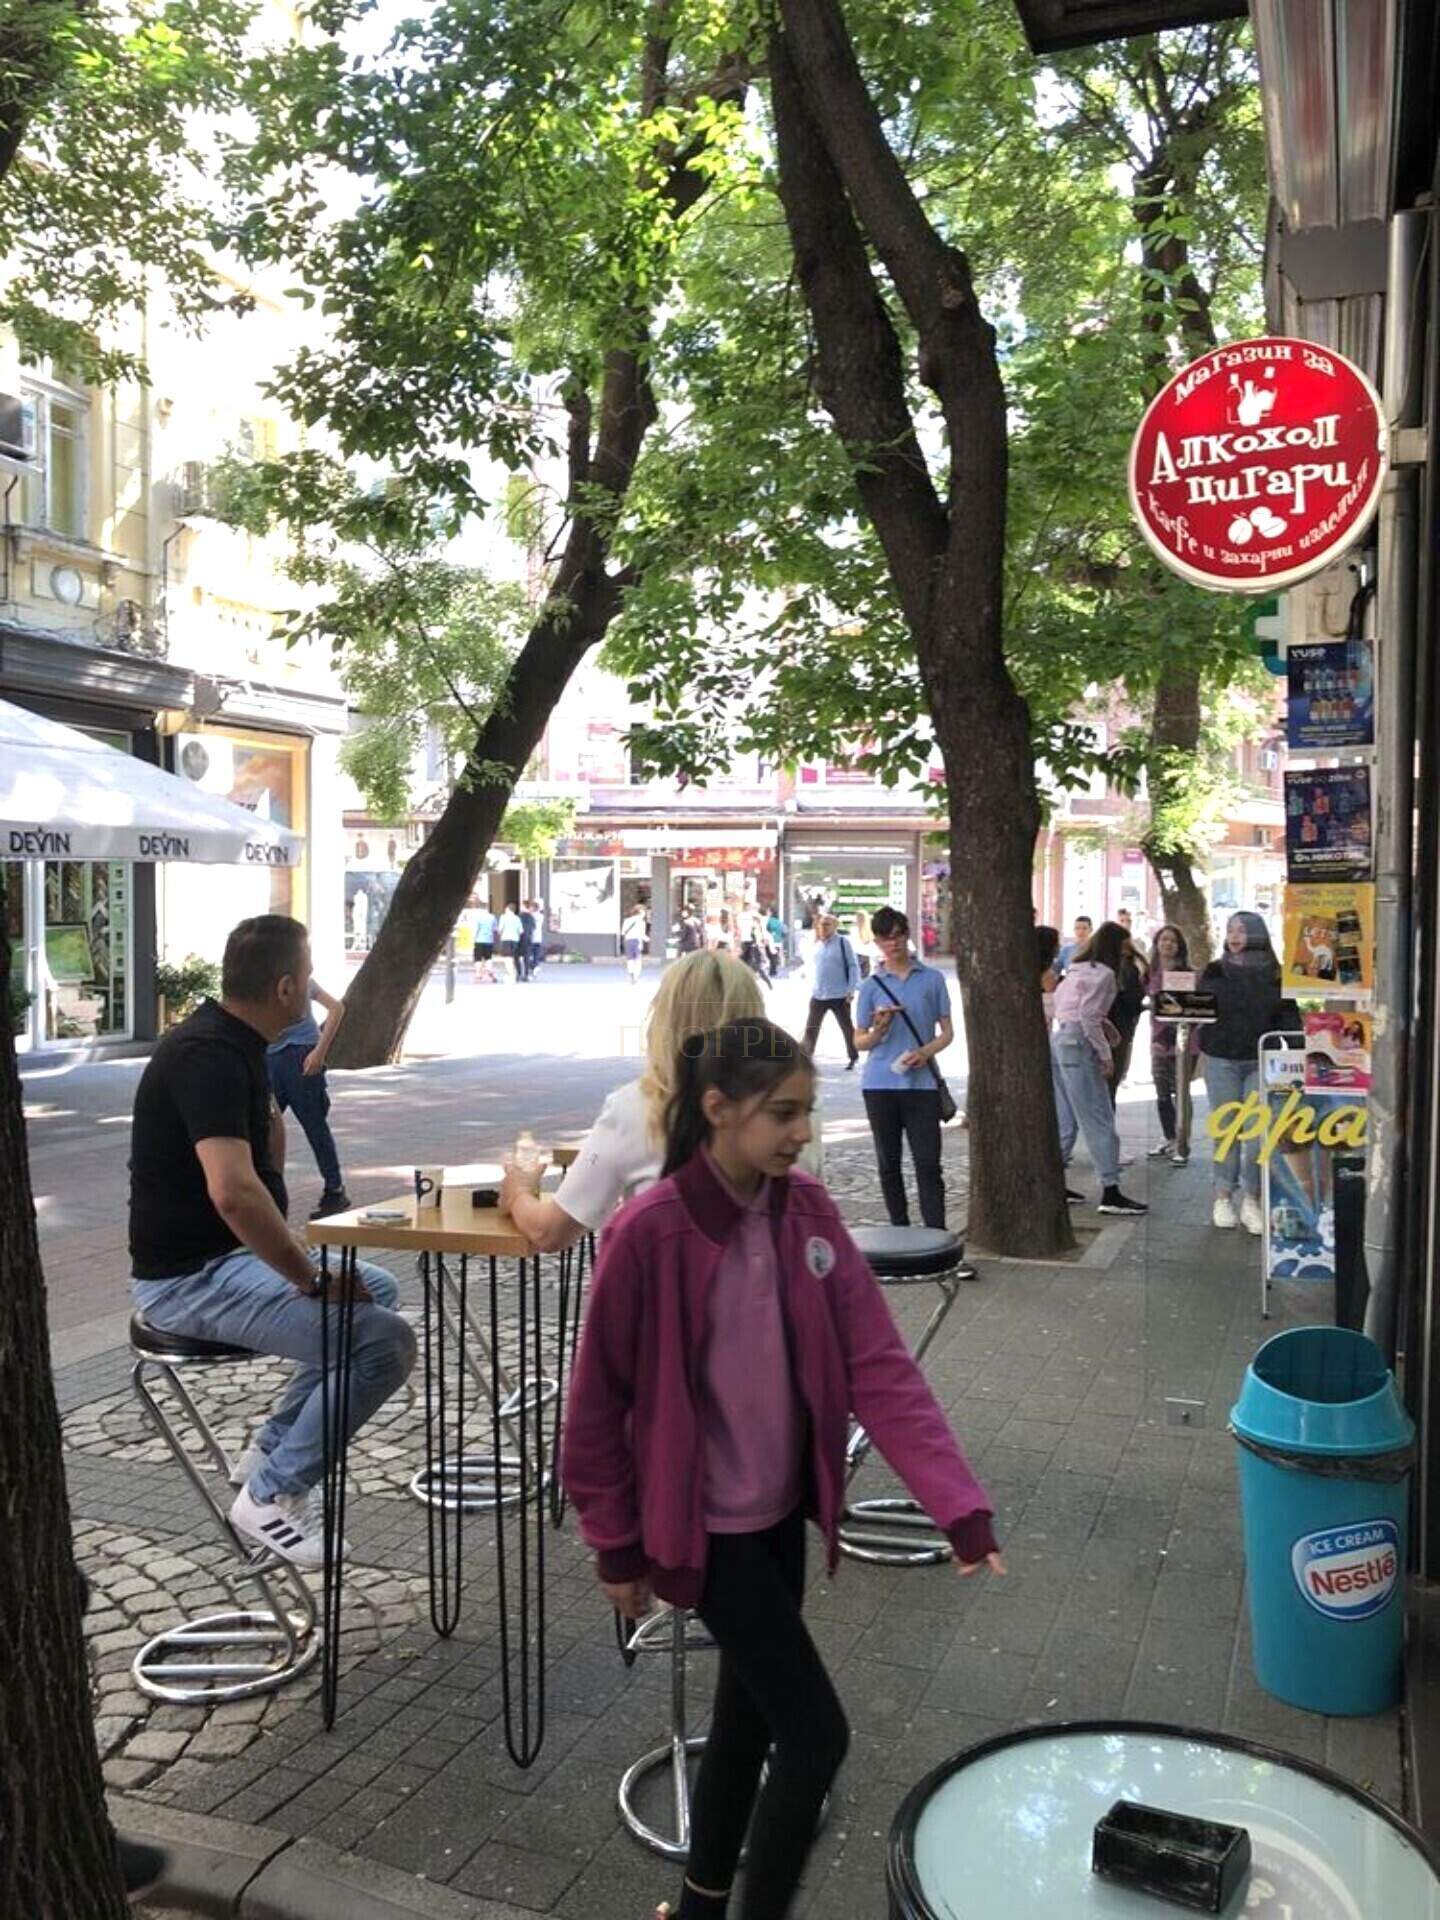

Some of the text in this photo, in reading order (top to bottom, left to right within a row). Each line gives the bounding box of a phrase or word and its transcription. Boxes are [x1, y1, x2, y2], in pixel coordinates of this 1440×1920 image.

[1303, 349, 1336, 377] за
[1203, 544, 1216, 560] и
[9, 827, 71, 854] DEVIN
[139, 833, 189, 857] DEVIN
[245, 842, 289, 862] DEVIN
[1308, 1528, 1385, 1554] ICE CREAM
[1310, 1551, 1394, 1596] Nestlé
